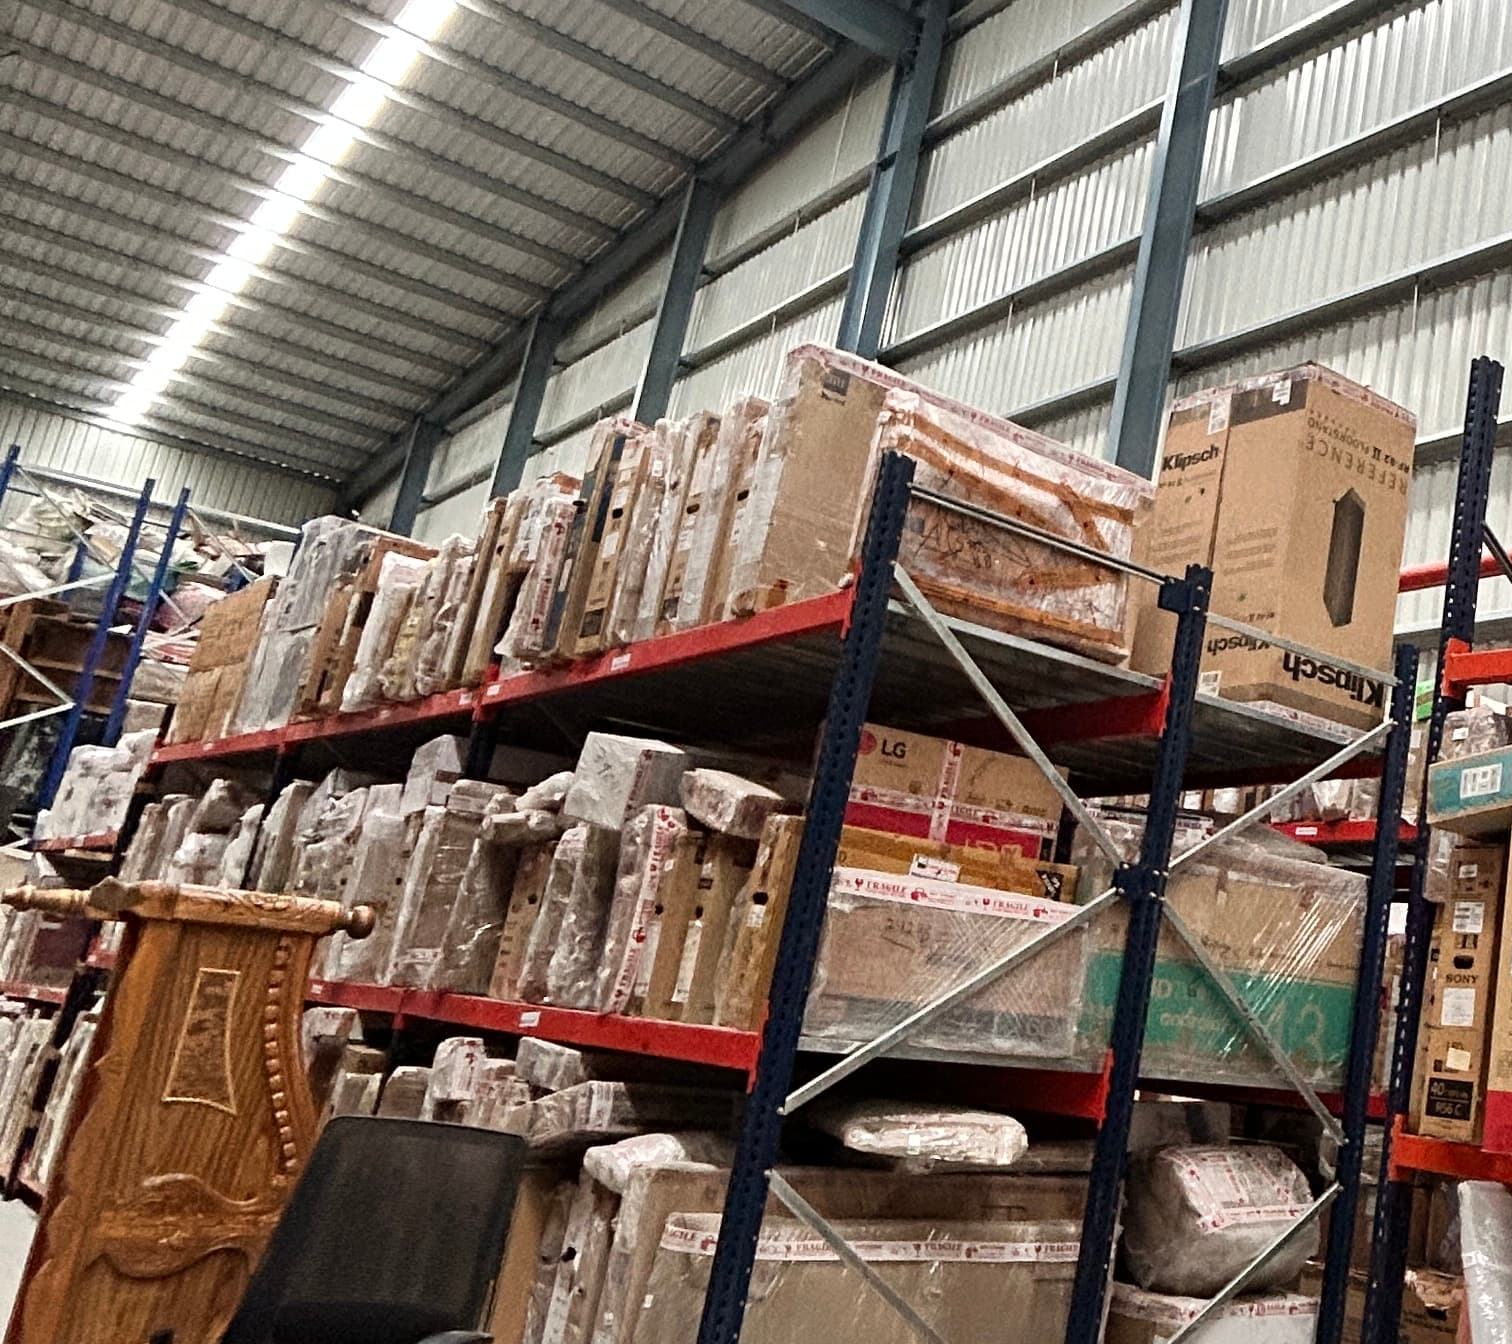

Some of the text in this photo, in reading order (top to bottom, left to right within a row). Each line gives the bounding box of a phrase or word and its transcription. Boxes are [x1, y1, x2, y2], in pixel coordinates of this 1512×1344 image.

[1162, 444, 1219, 471] Klipsch
[1305, 433, 1408, 496] REFERENCE
[1283, 650, 1384, 707] Klipsch
[881, 739, 906, 759] LG
[866, 880, 908, 896] FRAGILE
[1446, 973, 1478, 984] SONY
